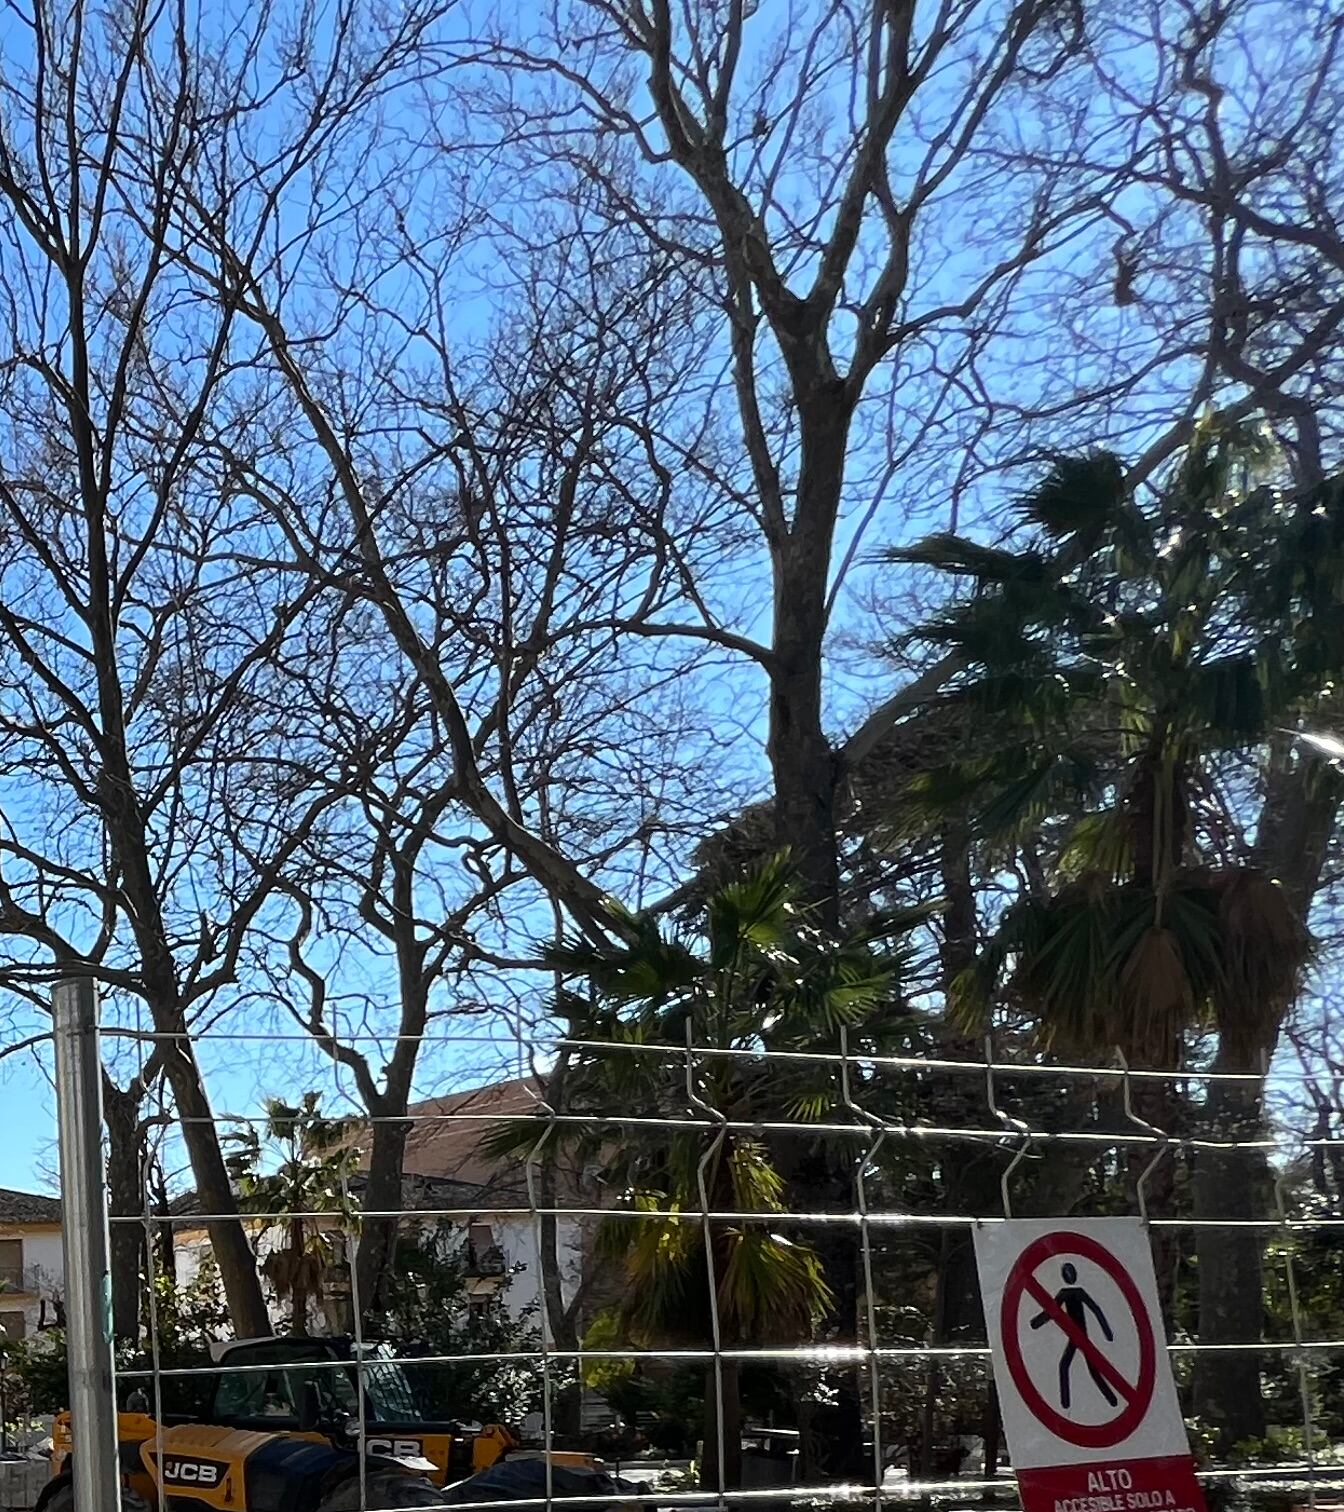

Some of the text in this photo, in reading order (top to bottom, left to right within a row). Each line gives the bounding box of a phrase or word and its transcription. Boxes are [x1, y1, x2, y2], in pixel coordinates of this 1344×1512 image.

[164, 1461, 218, 1483] JCB
[1088, 1469, 1132, 1492] ALTO
[1127, 1491, 1163, 1509] SOLO
[1166, 1489, 1177, 1506] A
